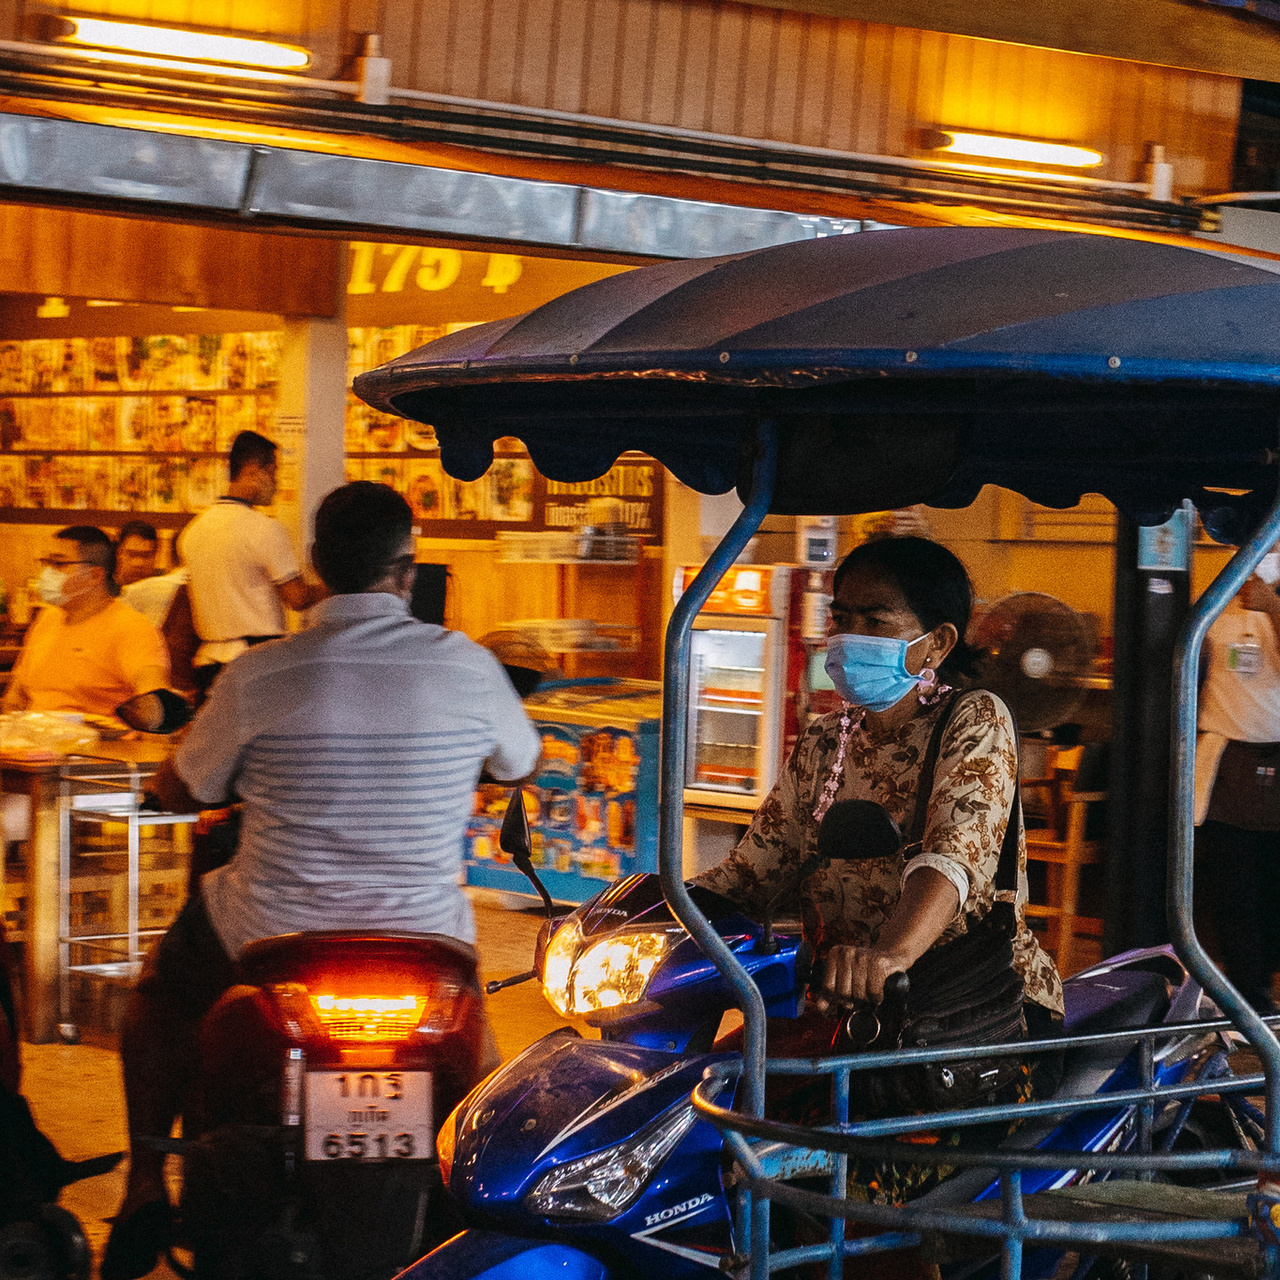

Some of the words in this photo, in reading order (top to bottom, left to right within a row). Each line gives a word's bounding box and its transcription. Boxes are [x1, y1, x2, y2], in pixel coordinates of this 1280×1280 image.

[347, 241, 463, 295] 175
[322, 1131, 416, 1158] 6513
[644, 1191, 715, 1227] HONDA
